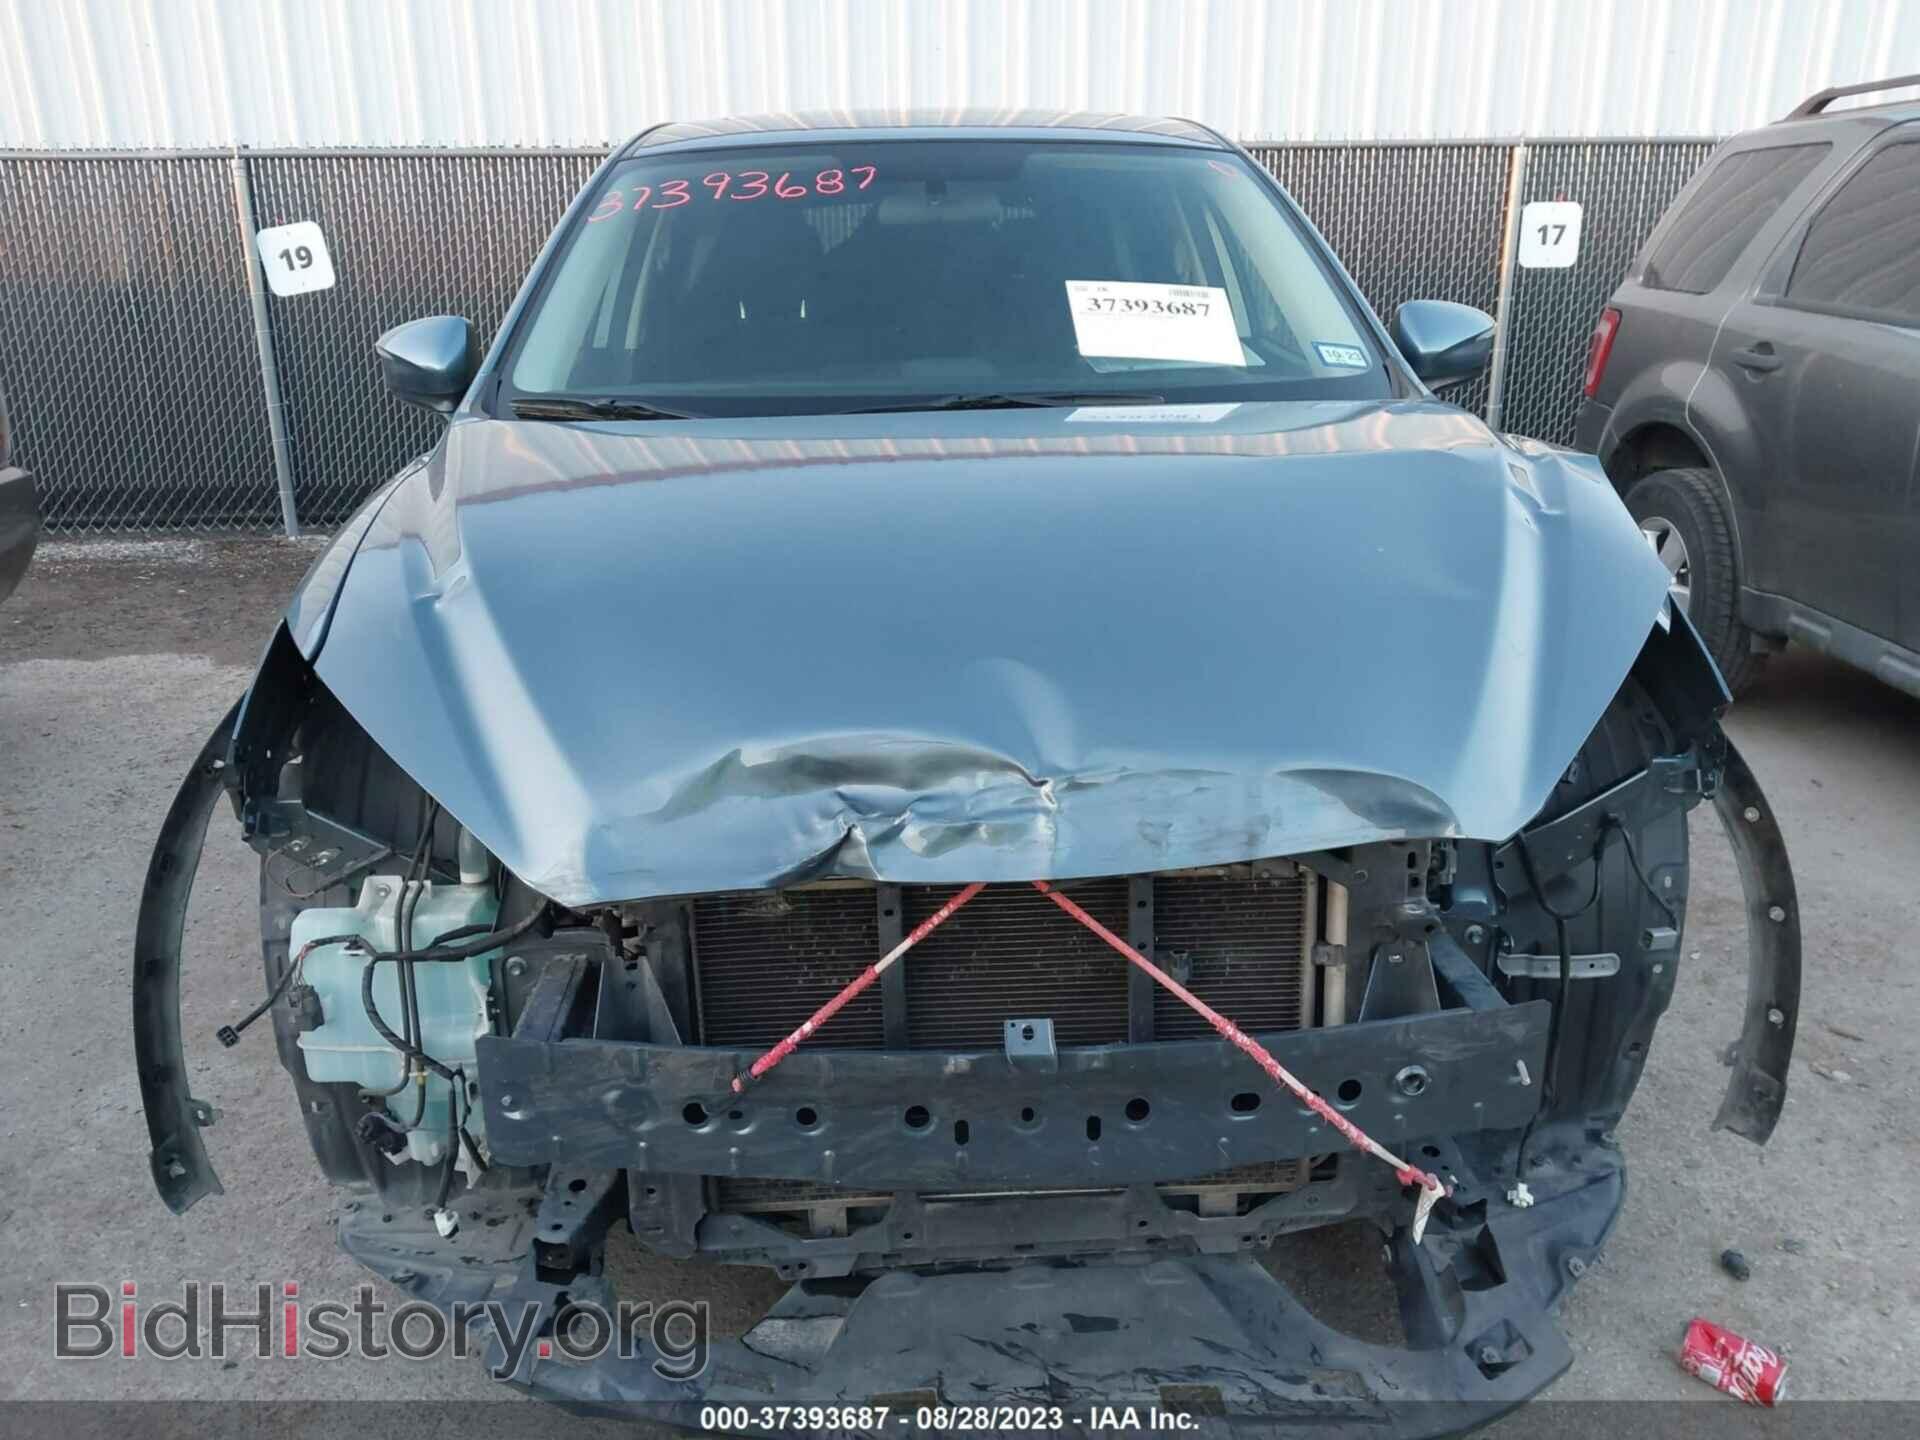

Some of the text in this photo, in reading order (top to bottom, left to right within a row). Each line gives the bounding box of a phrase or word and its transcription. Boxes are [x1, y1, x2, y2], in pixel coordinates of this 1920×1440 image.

[587, 164, 877, 223] 37393687
[1537, 224, 1567, 246] 17
[279, 245, 313, 272] 19
[1087, 296, 1211, 318] 37393687
